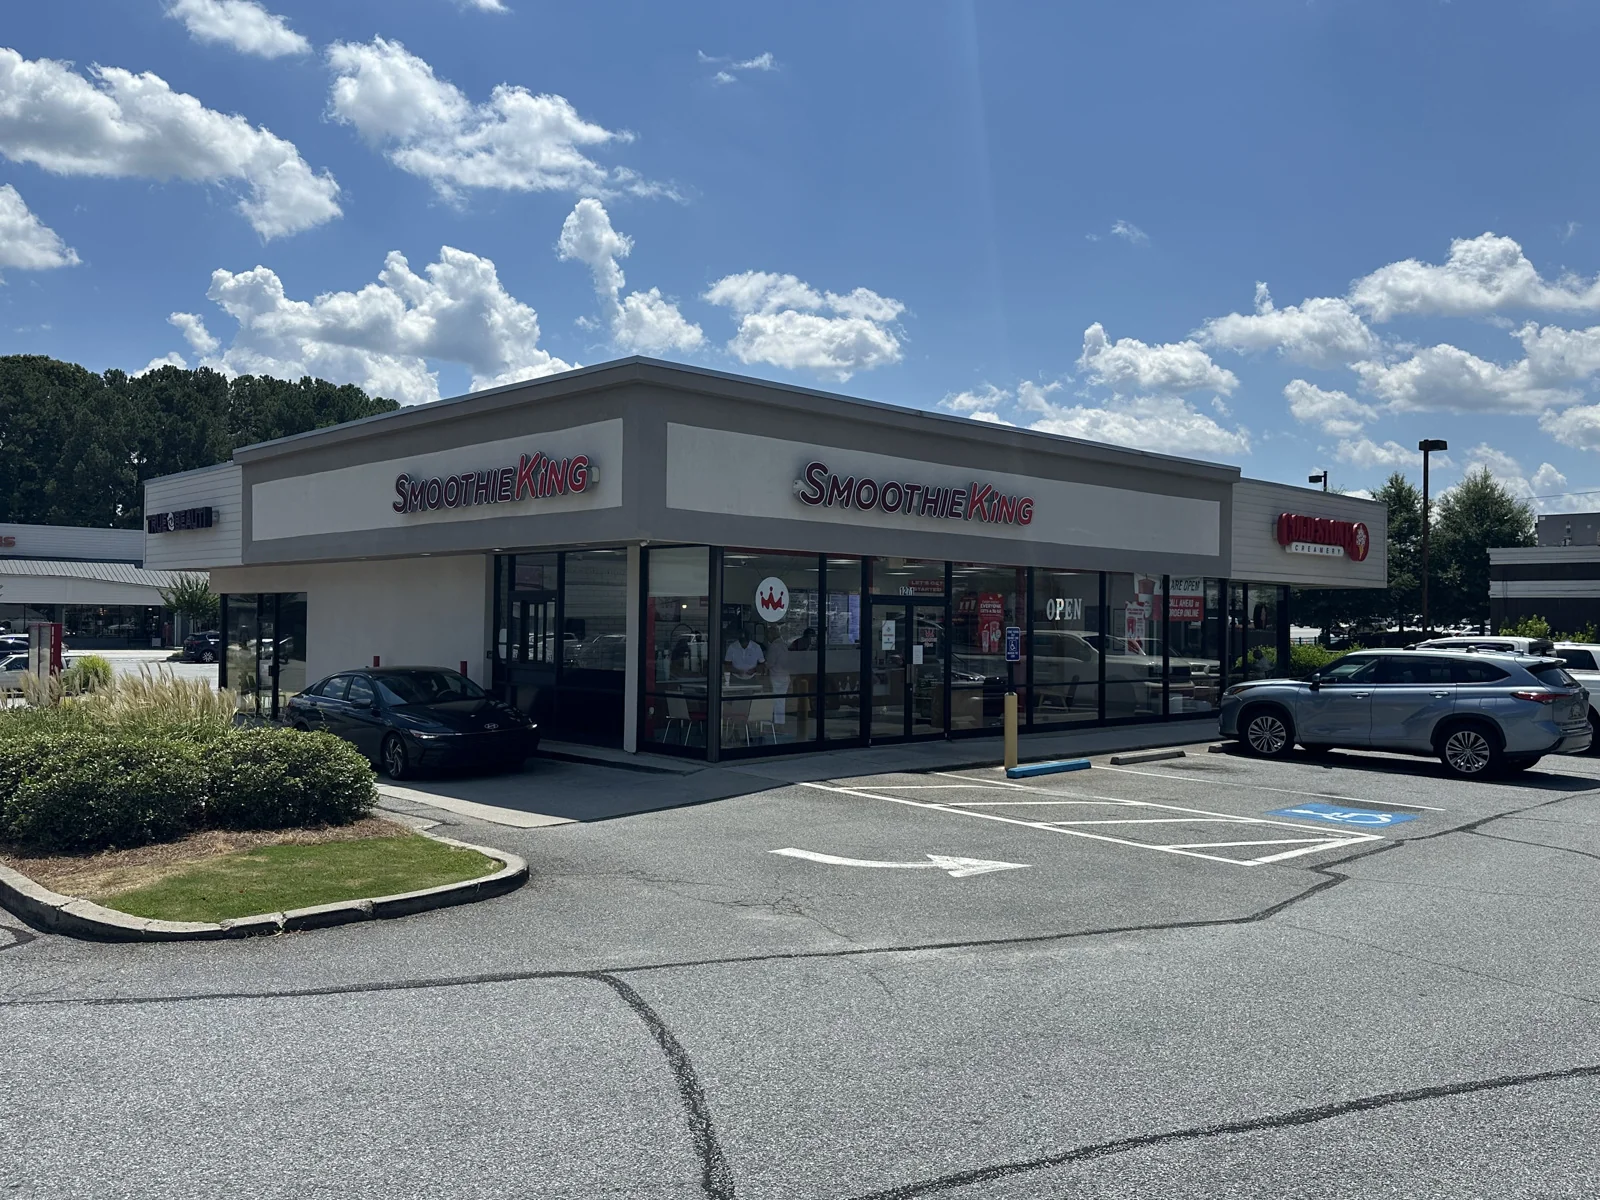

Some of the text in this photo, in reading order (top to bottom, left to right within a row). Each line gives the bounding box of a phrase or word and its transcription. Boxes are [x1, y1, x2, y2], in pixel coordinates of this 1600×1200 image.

[1294, 545, 1341, 555] CREAMERY
[1171, 580, 1184, 590] ARE
[1183, 580, 1200, 591] OPEN
[1179, 599, 1194, 607] AHEAD
[1046, 598, 1083, 621] OPEN
[1183, 609, 1199, 617] ONLINE
